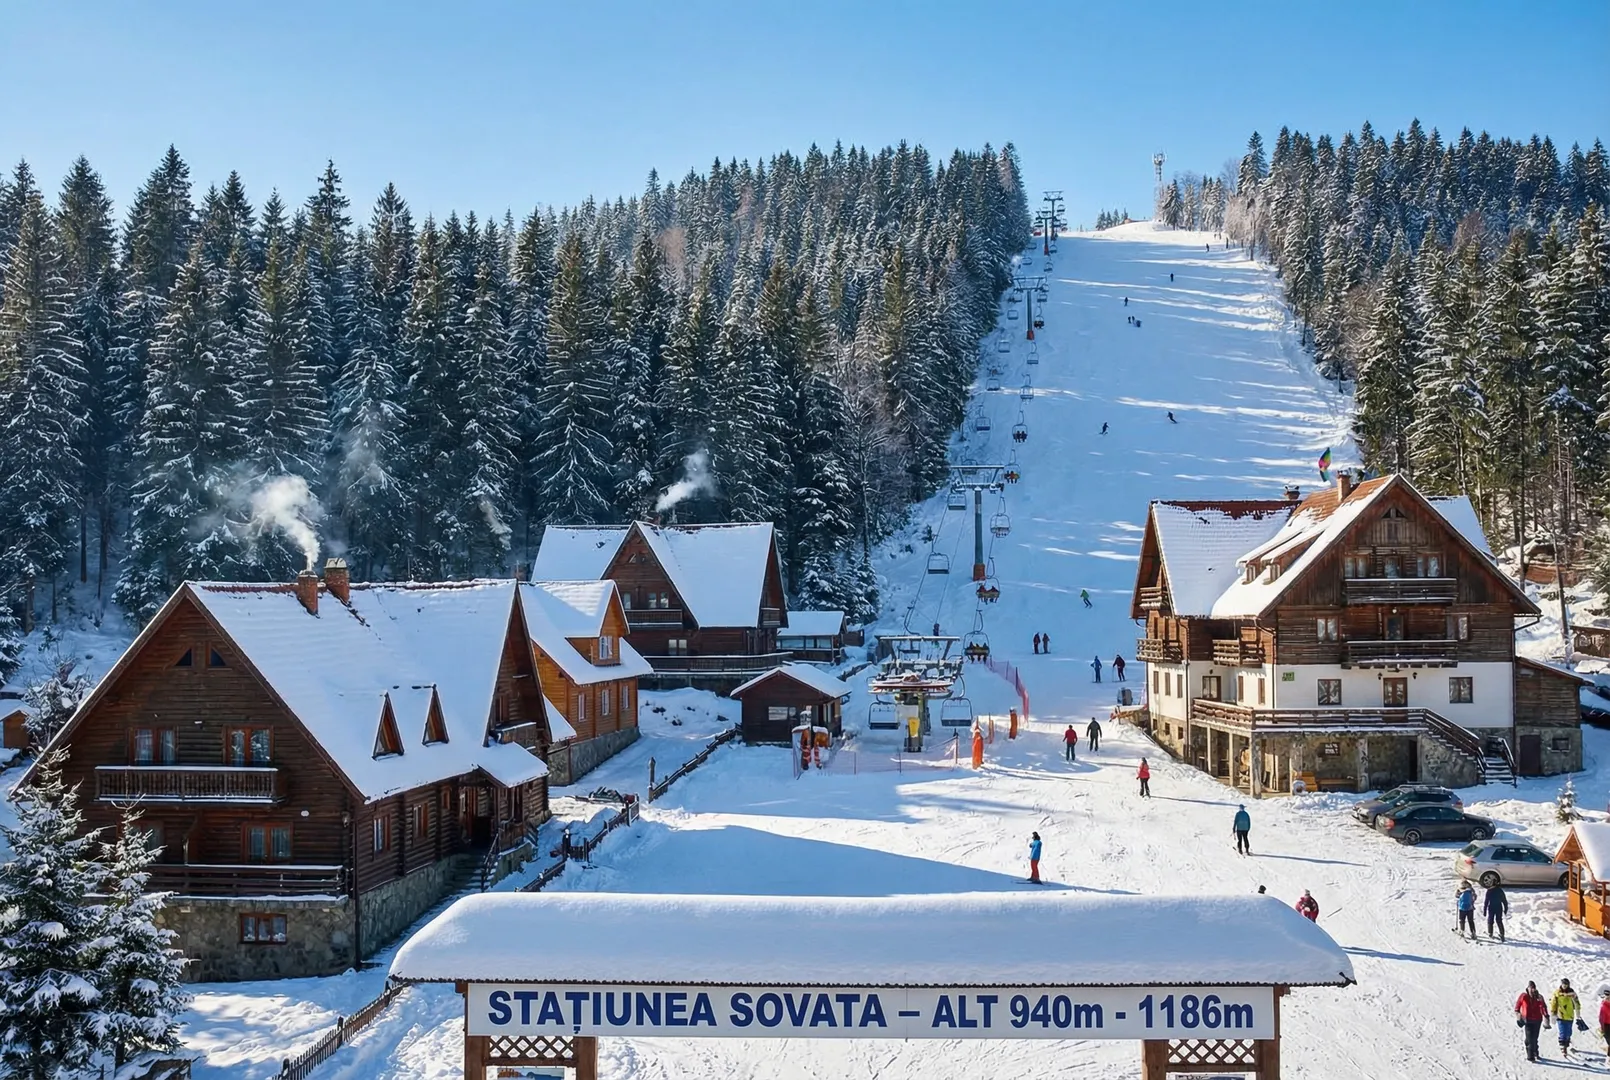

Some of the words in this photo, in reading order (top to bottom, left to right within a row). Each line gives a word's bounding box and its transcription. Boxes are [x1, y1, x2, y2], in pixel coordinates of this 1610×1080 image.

[488, 990, 717, 1034] STAȚIUNEA
[730, 993, 888, 1028] SOVATA
[931, 995, 998, 1028] ALT
[1010, 995, 1103, 1028] 940m
[1139, 995, 1253, 1028] 1186m
